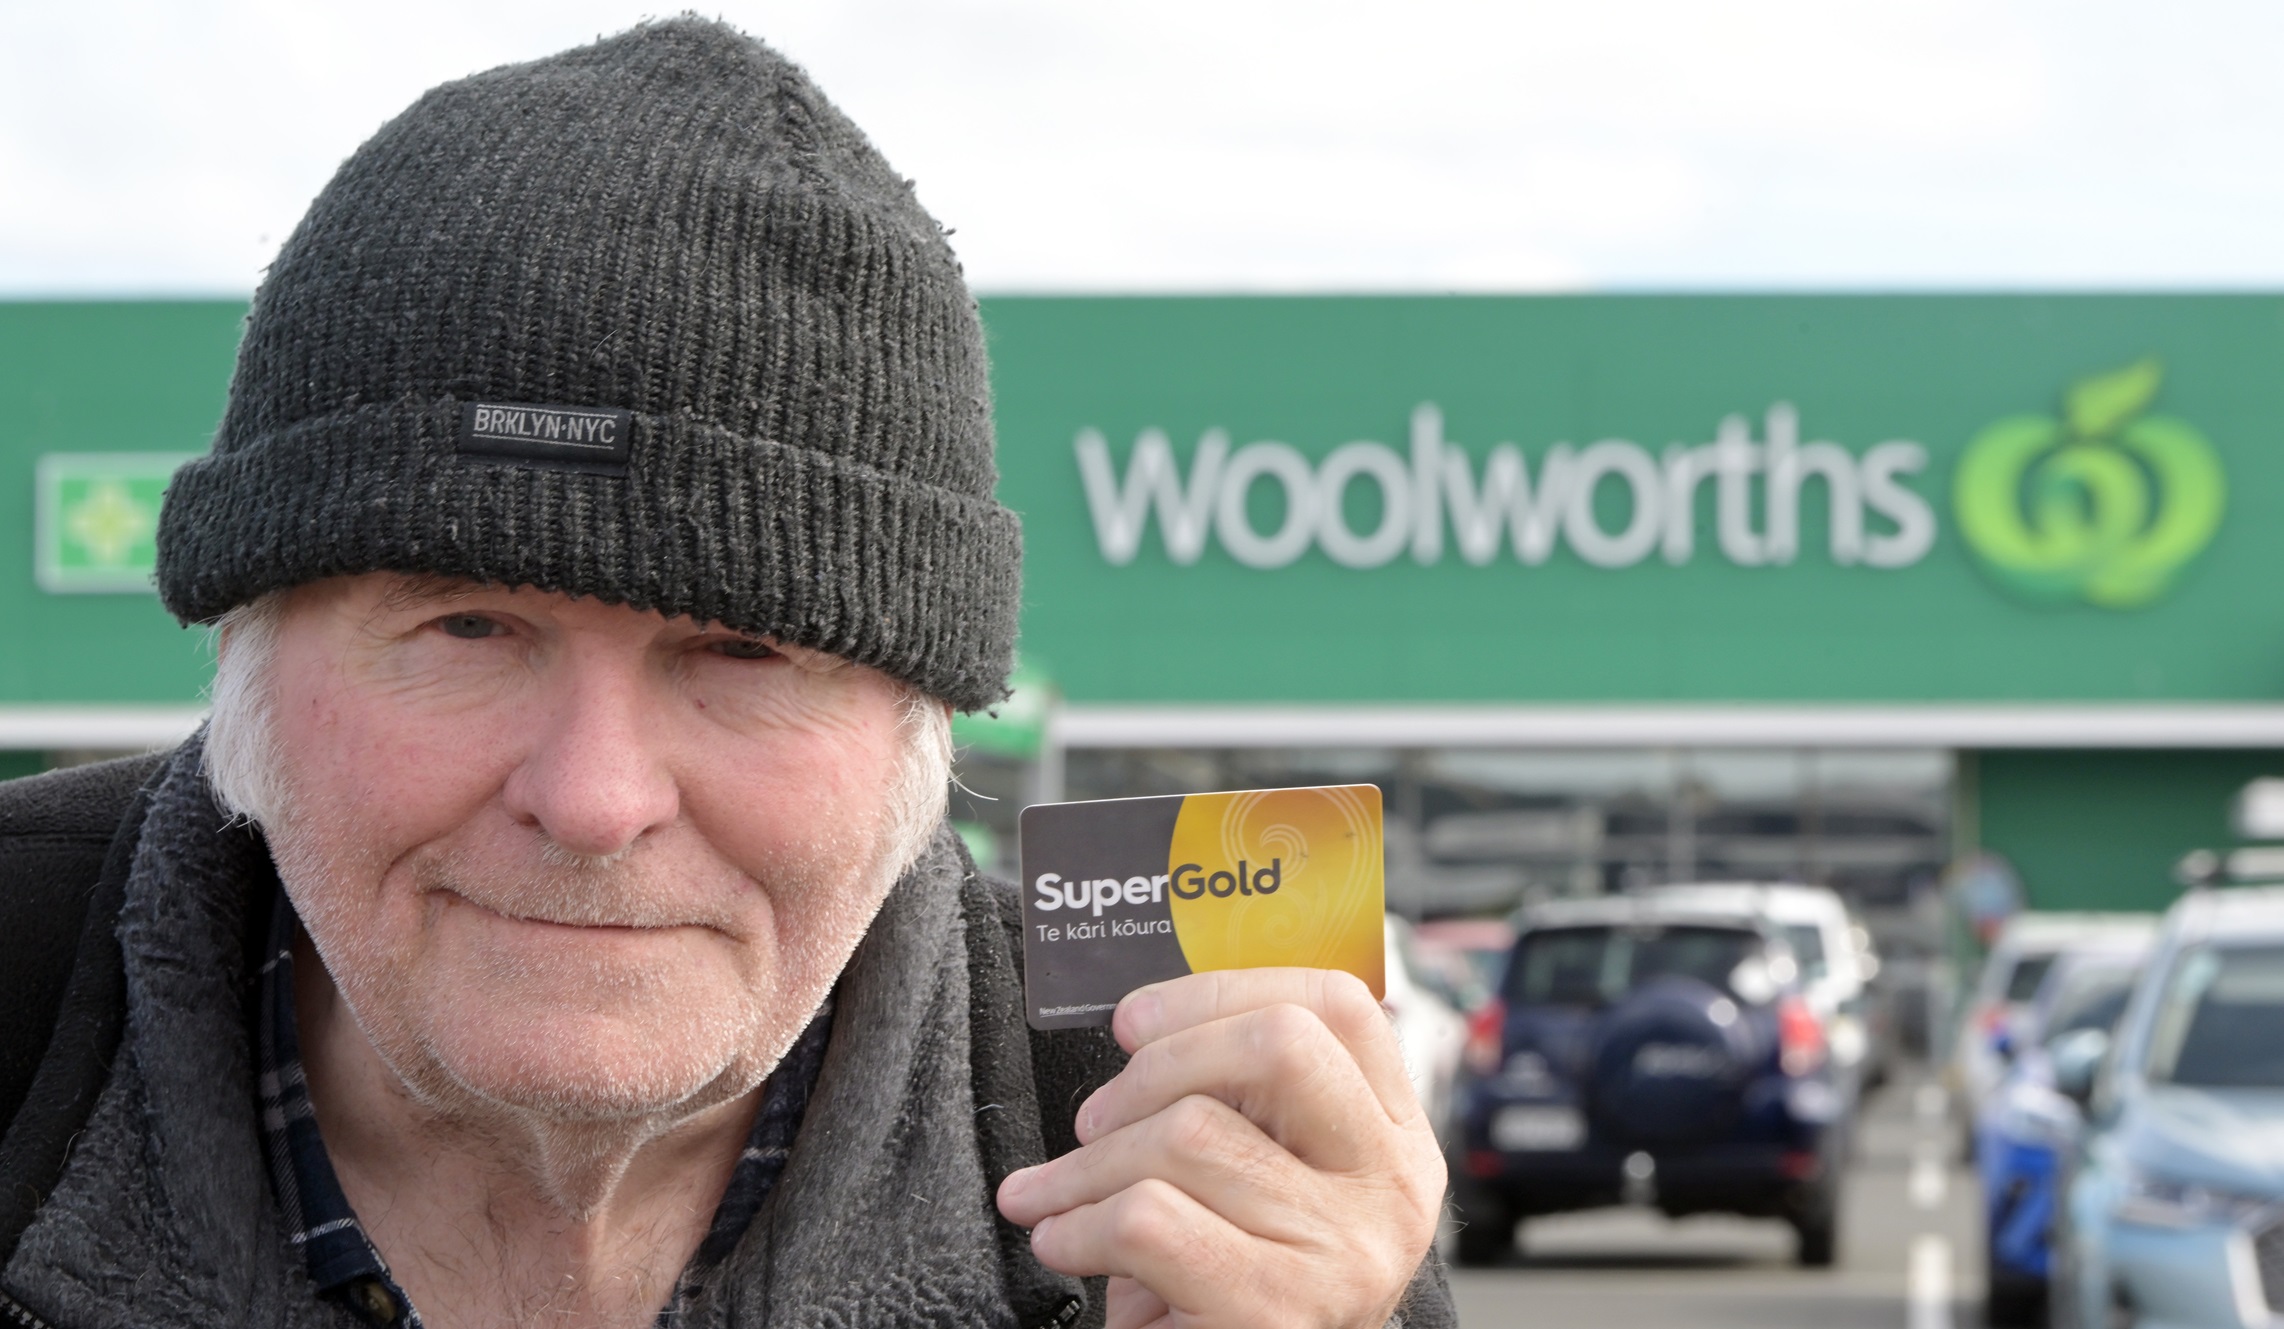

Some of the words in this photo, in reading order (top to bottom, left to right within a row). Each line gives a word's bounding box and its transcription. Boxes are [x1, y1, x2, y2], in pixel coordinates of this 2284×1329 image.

[1073, 401, 1938, 571] Woolworths
[1034, 858, 1281, 917] SuperGold
[1036, 924, 1060, 942] Te
[1066, 921, 1106, 941] kāri
[1112, 919, 1172, 937] kōura
